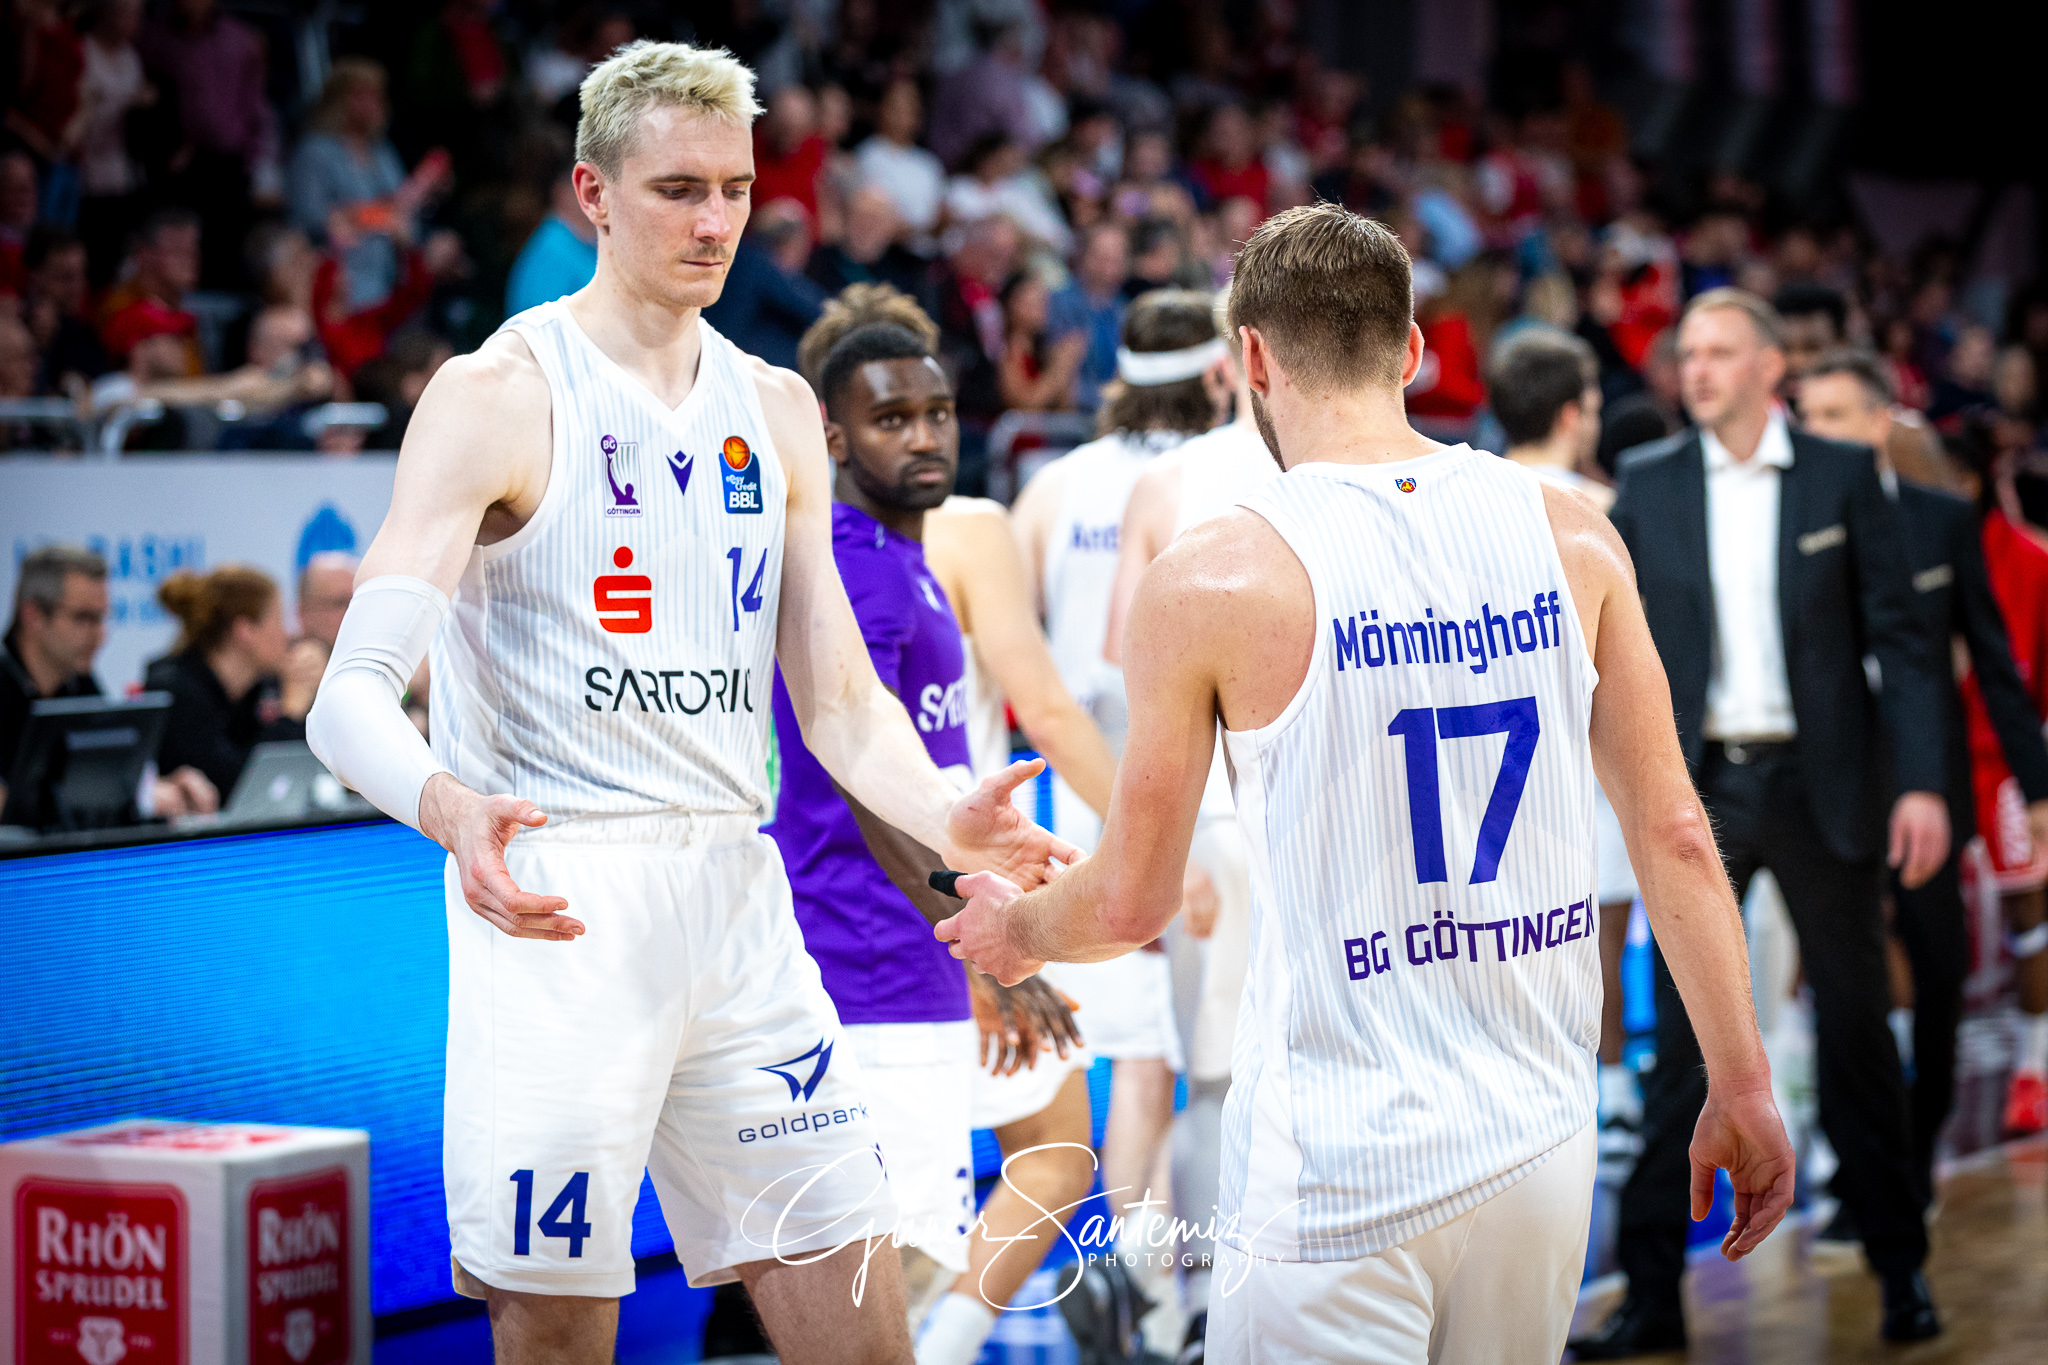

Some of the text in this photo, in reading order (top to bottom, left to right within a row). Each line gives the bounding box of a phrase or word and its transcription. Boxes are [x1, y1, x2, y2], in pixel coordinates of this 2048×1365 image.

[603, 440, 616, 450] BG
[606, 507, 641, 515] GÖTTINGEN
[729, 491, 759, 508] BBL
[726, 547, 767, 632] 14
[1332, 591, 1561, 674] Mönninghoff
[1387, 696, 1540, 885] 17
[1344, 930, 1391, 981] BG
[1405, 893, 1595, 966] GÖTTINGEN
[36, 1205, 167, 1272] RHÖN
[509, 1169, 591, 1258] 14
